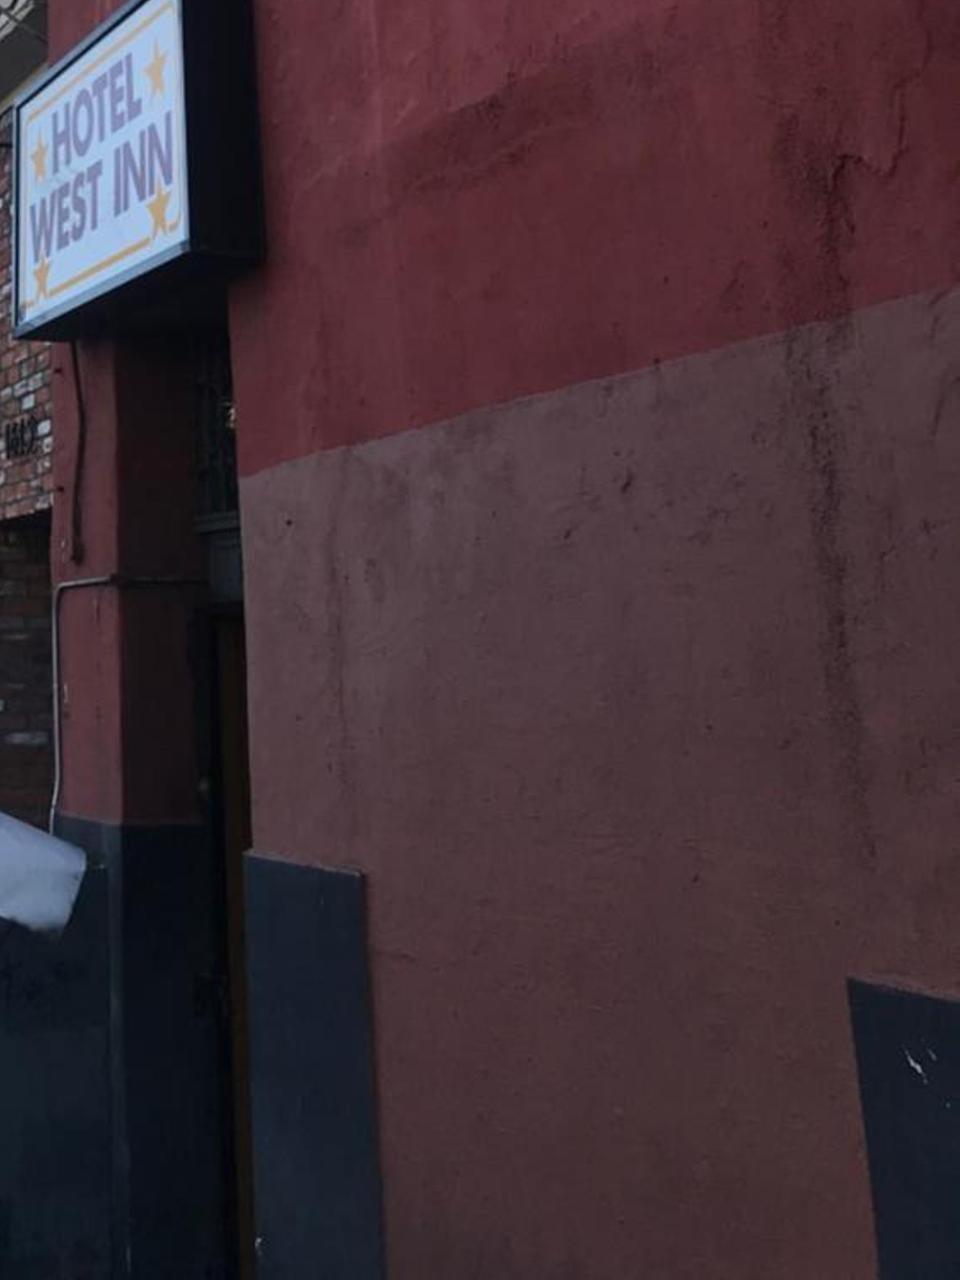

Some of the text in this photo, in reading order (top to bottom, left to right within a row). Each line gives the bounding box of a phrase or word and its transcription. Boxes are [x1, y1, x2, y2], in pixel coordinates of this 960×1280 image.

[50, 52, 143, 176] HOTEL
[28, 110, 173, 263] WEST INN
